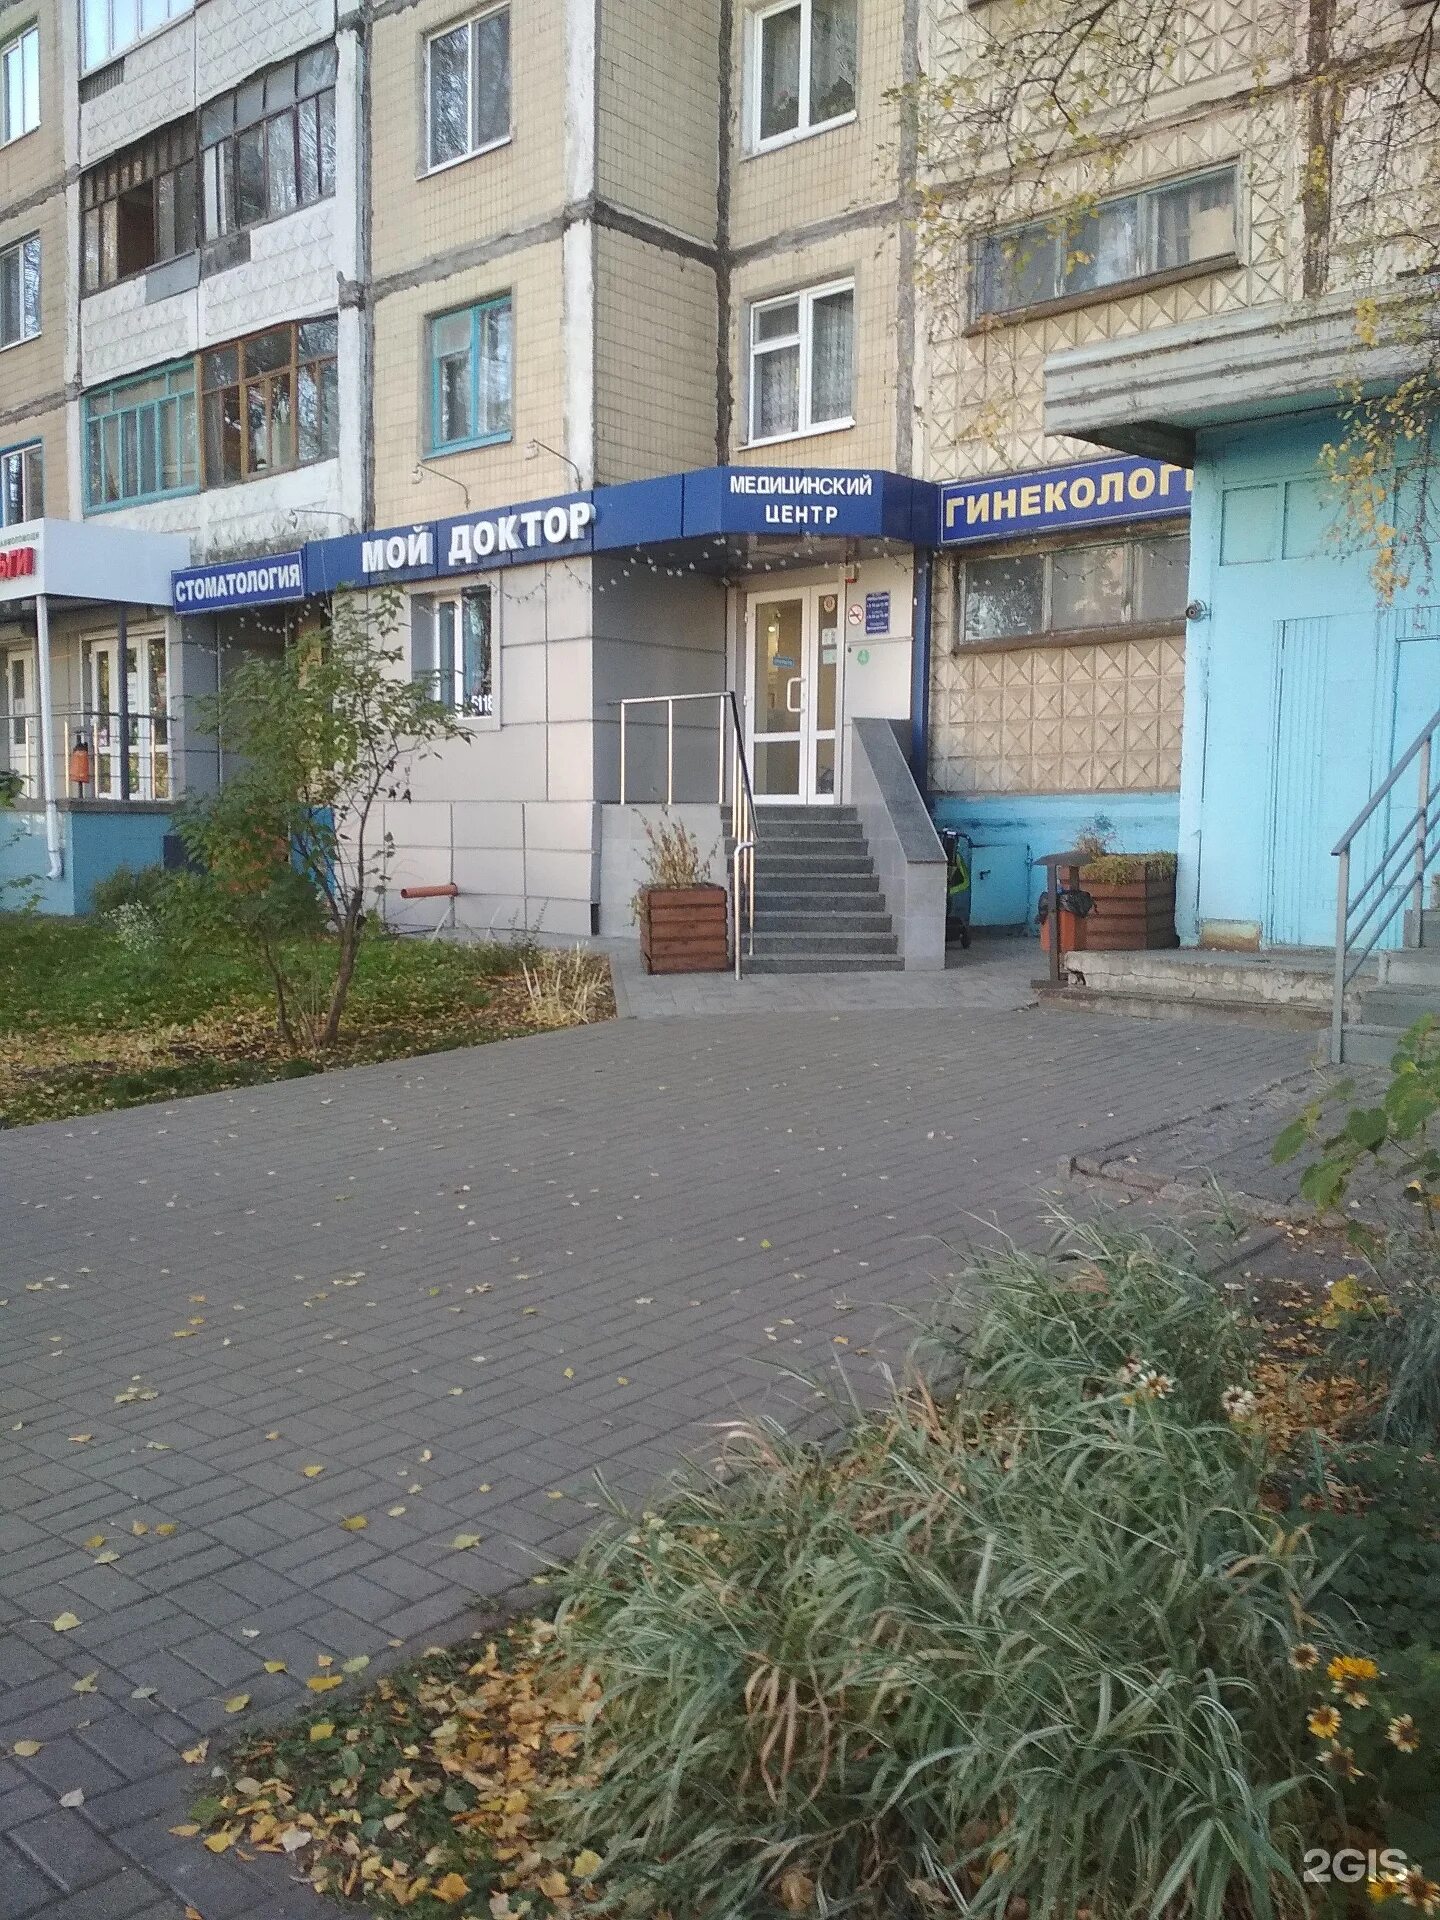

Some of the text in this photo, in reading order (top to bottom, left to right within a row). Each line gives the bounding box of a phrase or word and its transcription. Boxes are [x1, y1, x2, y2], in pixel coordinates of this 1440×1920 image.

[730, 474, 872, 496] МЕДИЦИНСКИЙ
[765, 504, 838, 524] ЦЕНТР
[362, 502, 595, 573] МОЙ ДОКТОР
[175, 564, 300, 602] СТОМАТОЛОГИЯ
